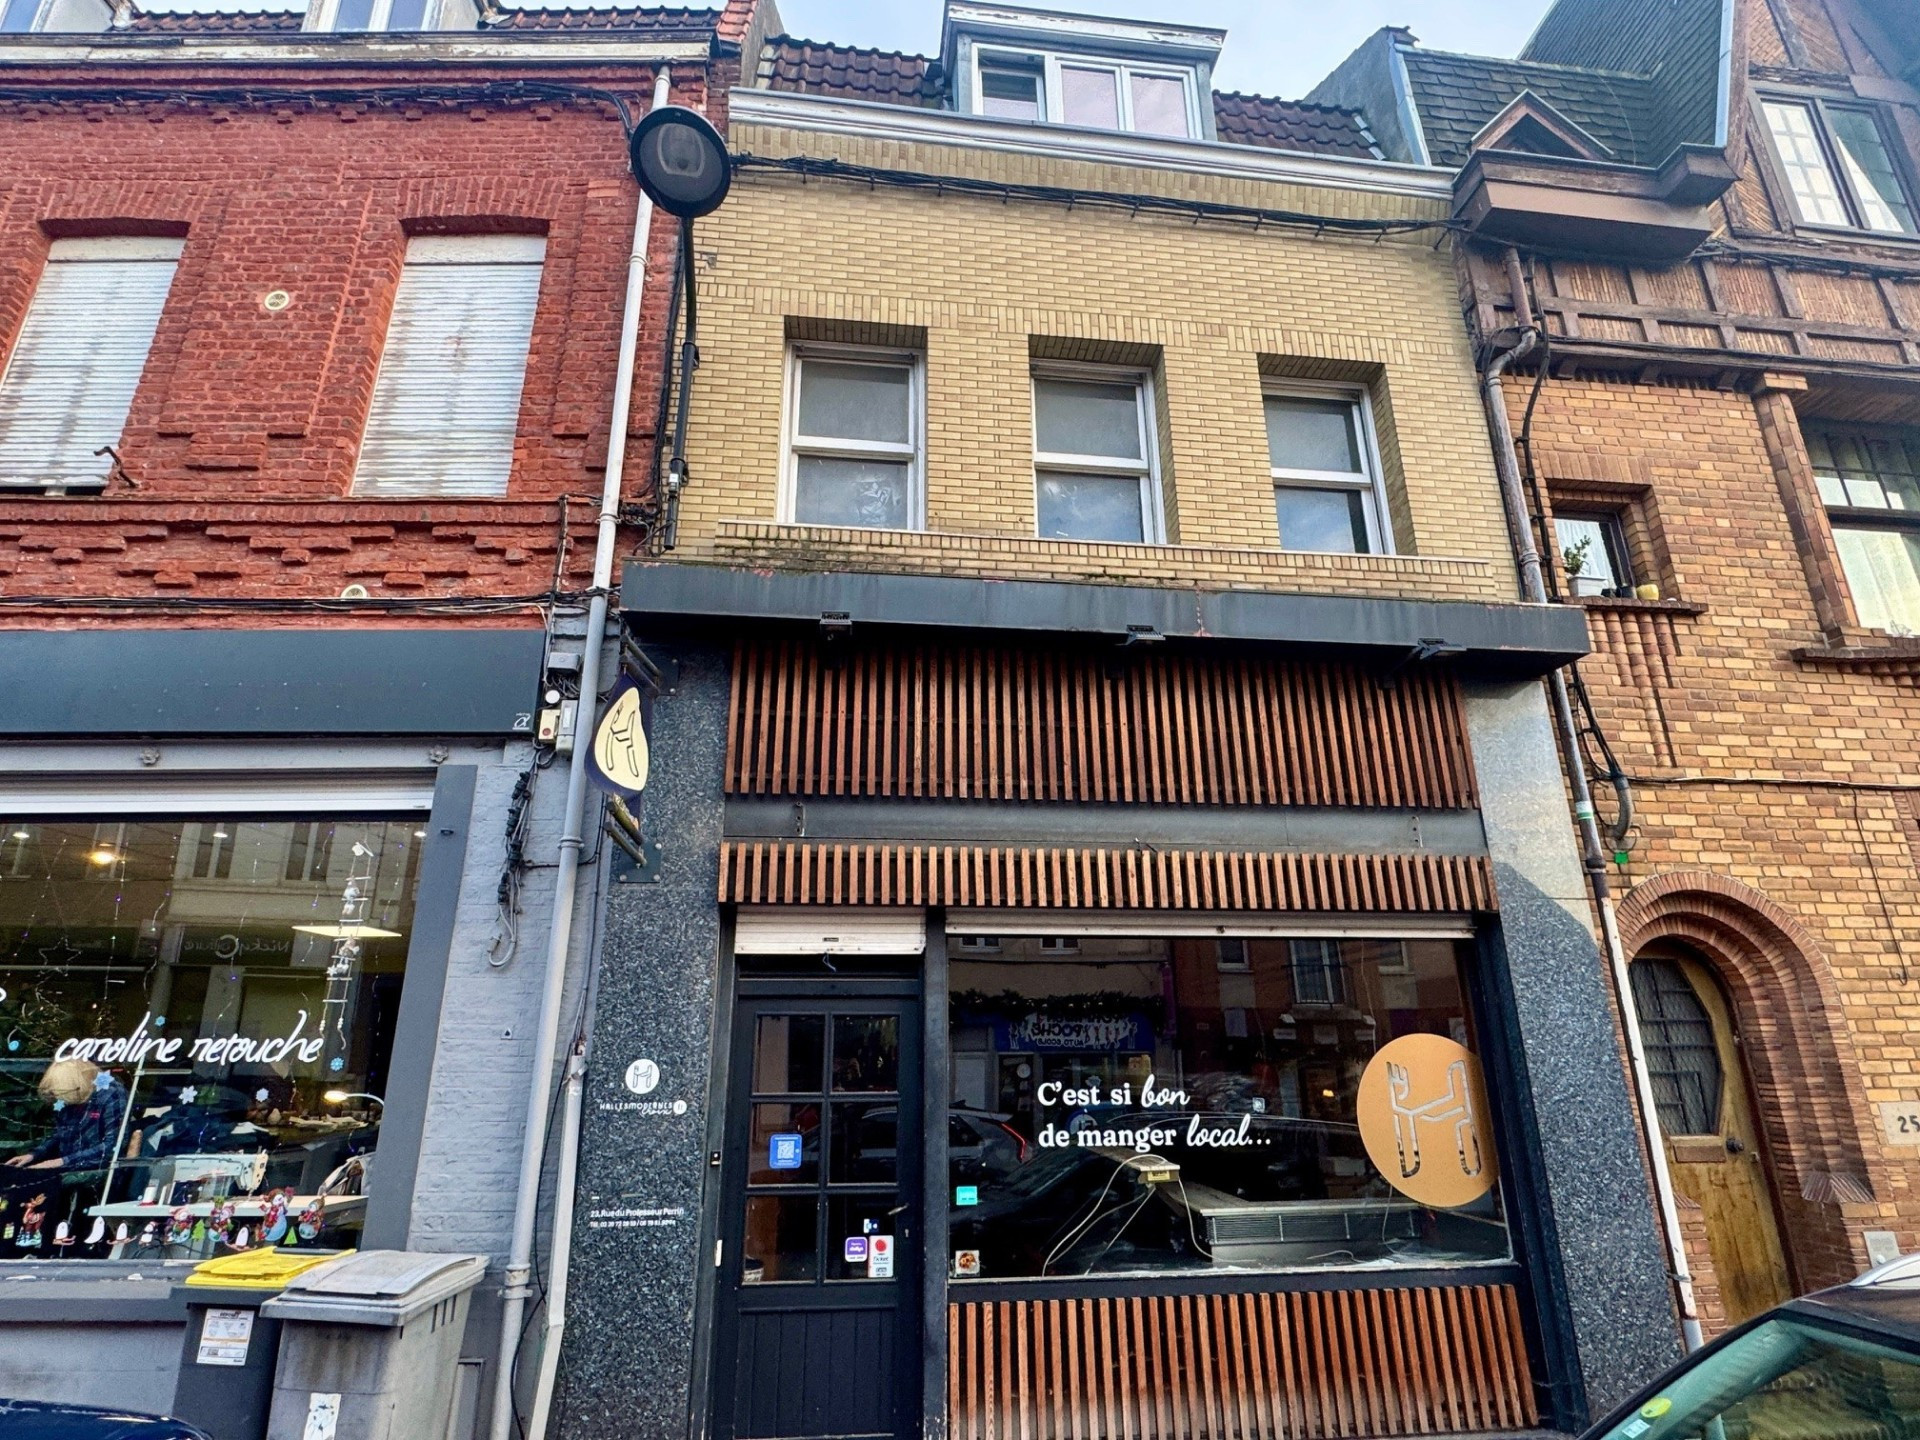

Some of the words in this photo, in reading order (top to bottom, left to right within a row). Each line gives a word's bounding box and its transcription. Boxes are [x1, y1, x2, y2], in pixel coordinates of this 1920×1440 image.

[54, 1011, 183, 1063] caroline
[188, 1010, 324, 1065] retouche
[1037, 1082, 1101, 1106] C'est
[1110, 1083, 1132, 1105] si
[1141, 1073, 1190, 1108] bon
[1038, 1123, 1070, 1147] de
[1077, 1127, 1177, 1153] manger
[1897, 1114, 1920, 1133] 25
